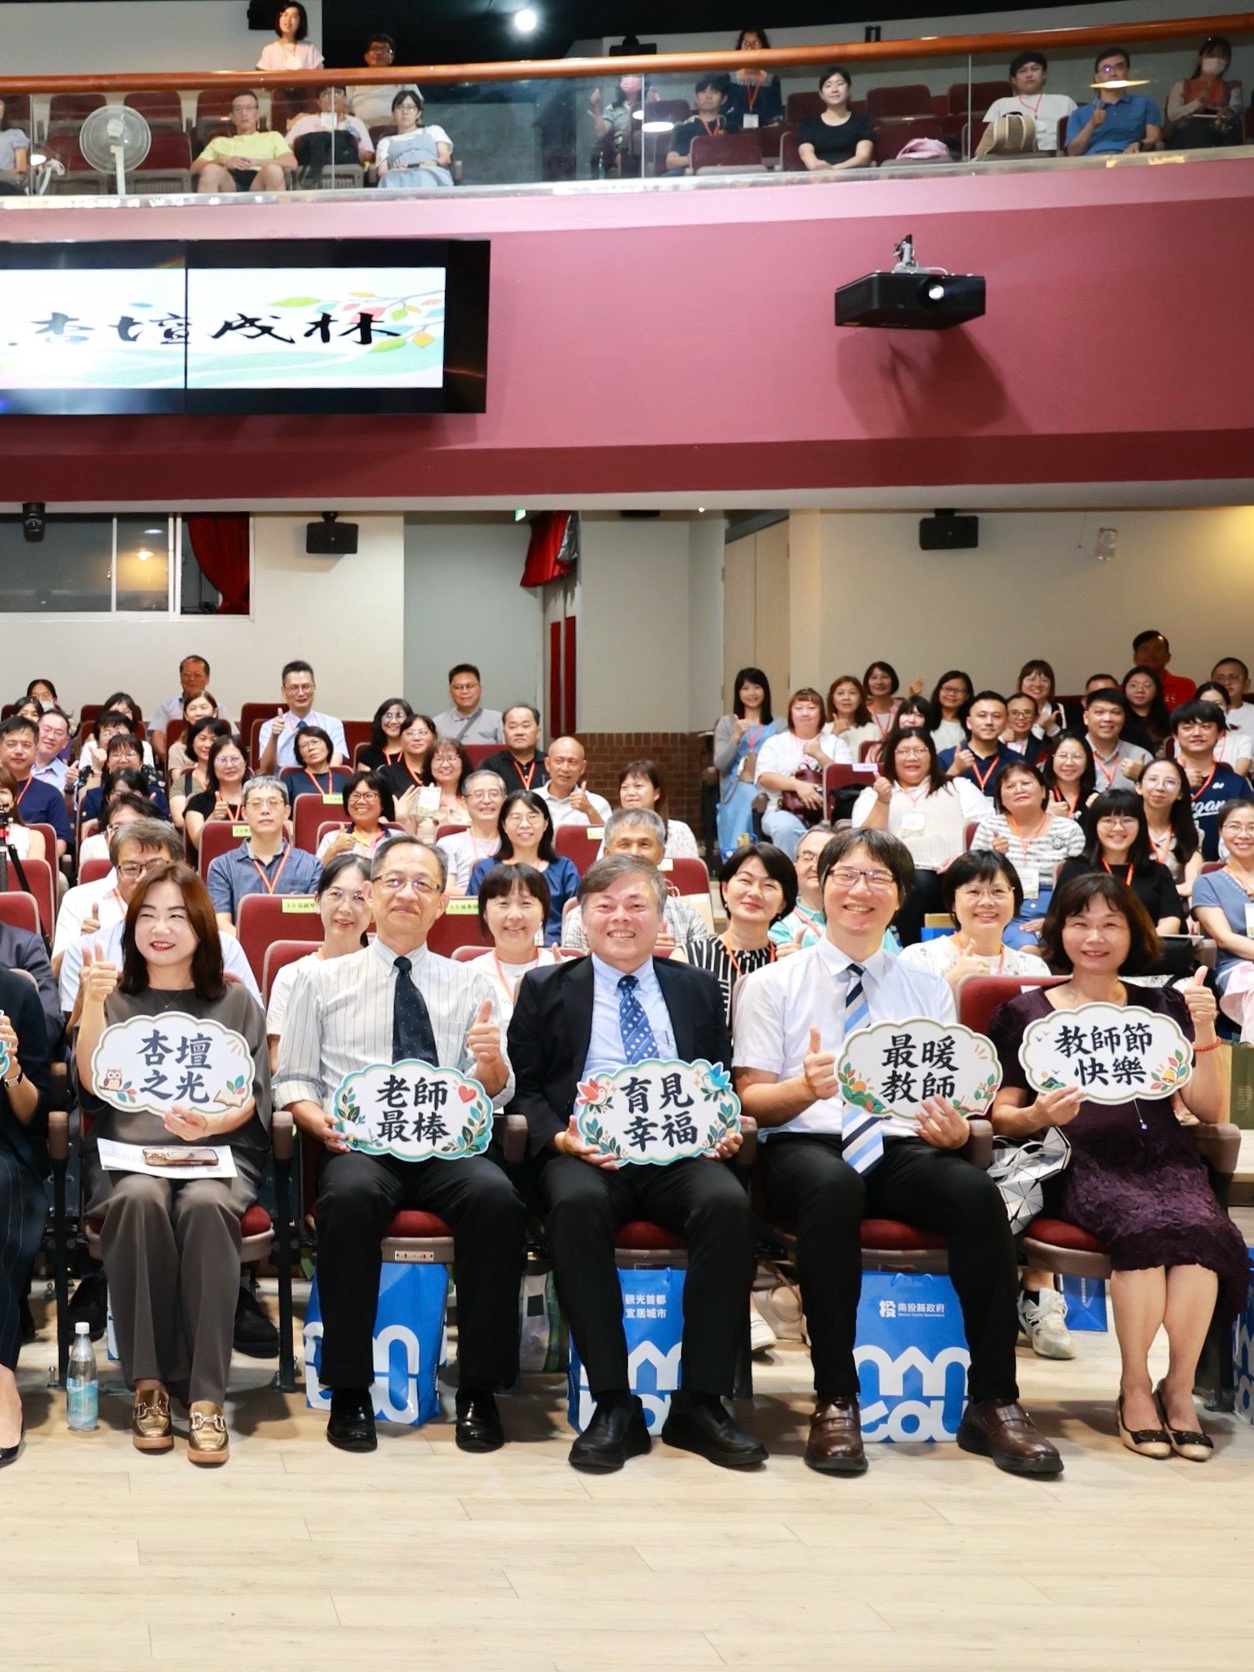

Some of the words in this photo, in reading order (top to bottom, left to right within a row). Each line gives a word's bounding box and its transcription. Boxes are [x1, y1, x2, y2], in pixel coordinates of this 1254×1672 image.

[137, 1030, 213, 1069] 杏壇
[882, 1034, 959, 1072] 最暖
[1054, 1023, 1153, 1058] 教師節
[140, 1069, 209, 1103] 之光
[879, 1070, 956, 1105] 教師
[1074, 1056, 1147, 1086] 快樂
[377, 1074, 448, 1110] 老師
[619, 1073, 695, 1113] 育見
[377, 1109, 451, 1148] 最棒
[622, 1112, 698, 1151] 幸福
[625, 1294, 667, 1306] 觀光首都
[625, 1308, 667, 1319] 宜居城市
[897, 1302, 945, 1313] 南投縣政府
